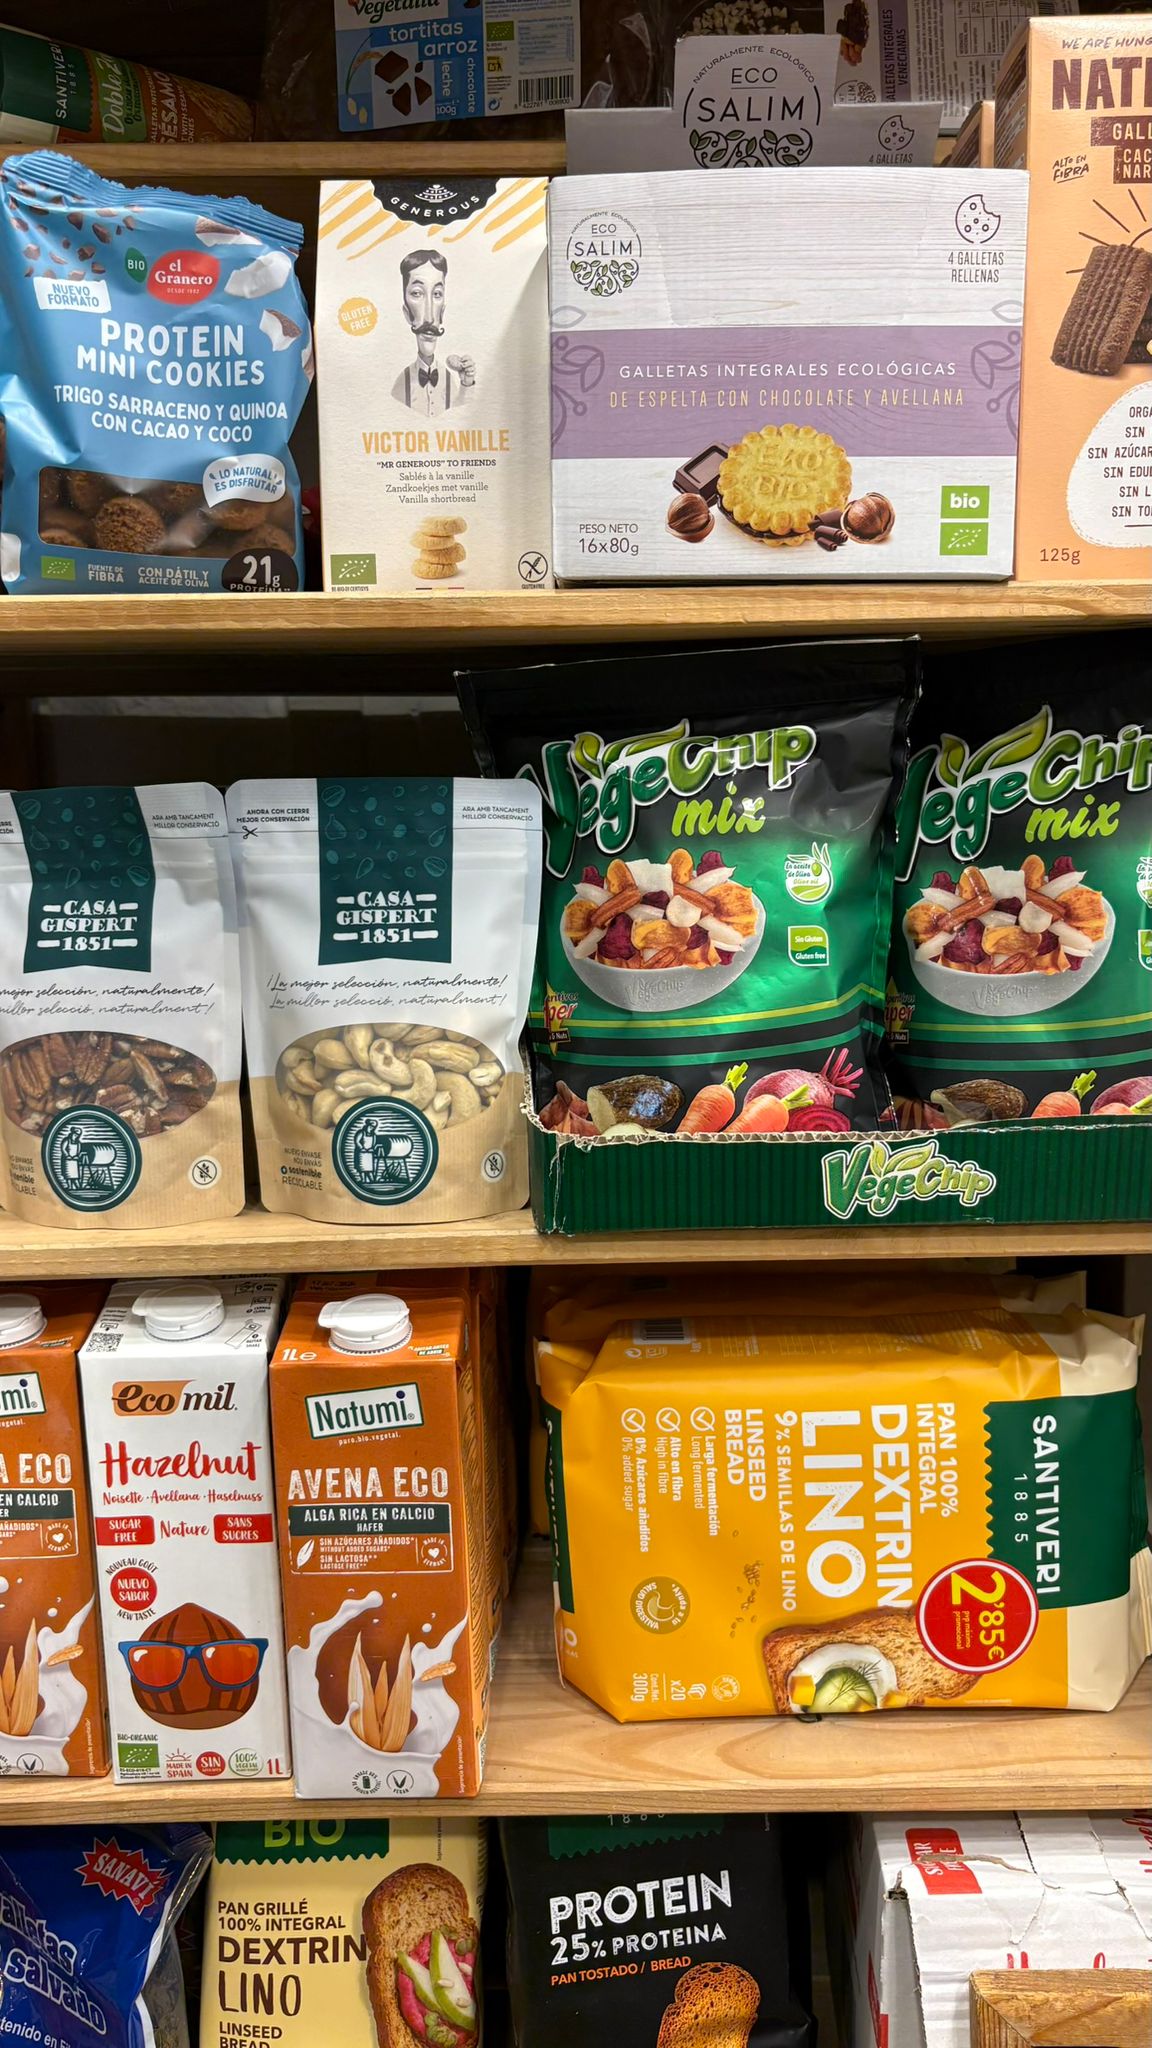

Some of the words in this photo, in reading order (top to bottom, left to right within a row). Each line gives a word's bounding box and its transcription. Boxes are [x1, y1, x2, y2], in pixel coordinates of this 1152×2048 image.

[389, 21, 463, 42] tortitas
[424, 39, 477, 57] arroz
[693, 45, 765, 84] NATURALMENTE
[769, 47, 815, 84] ECOLÓGICO
[897, 28, 906, 86] VENECIANAS
[442, 60, 453, 97] leche
[731, 68, 778, 84] ECO
[466, 57, 475, 113] chocolate
[697, 95, 804, 122] SALIM
[1052, 157, 1074, 169] ALTO
[1076, 155, 1087, 164] EN
[390, 195, 480, 217] GENEROUS
[591, 223, 617, 234] ECO
[574, 240, 632, 257] SALIM
[127, 259, 145, 271] BIO
[169, 258, 181, 272] el
[154, 270, 213, 285] Granero
[951, 269, 999, 283] RELLENAS
[52, 283, 90, 297] NUEVO
[47, 294, 100, 308] FORMATO
[350, 319, 371, 332] FREE
[101, 318, 244, 358] PROTEIN
[77, 345, 135, 379] MINI
[146, 360, 265, 388] COOKIES
[619, 364, 708, 379] GALLETAS
[717, 363, 829, 378] INTEGRALES
[837, 358, 957, 377] ECOLÓGICAS
[54, 384, 103, 406] TRIGO
[108, 392, 210, 422] SARRACENO
[214, 404, 225, 421] Y
[229, 401, 288, 422] QUINOA
[610, 391, 629, 409] DE
[639, 390, 707, 408] ESPELTA
[718, 390, 749, 407] CON
[759, 389, 854, 407] CHOCOLATE
[863, 389, 871, 406] Y
[881, 388, 964, 407] AVELLANA
[91, 412, 127, 433] CON
[131, 418, 190, 440] CACAO
[193, 423, 202, 440] Y
[208, 425, 252, 443] COCO
[1125, 426, 1145, 438] SIN
[362, 431, 430, 454] VICTOR
[436, 429, 510, 452] VANILLE
[399, 471, 427, 481] Sablés
[429, 472, 434, 481] à
[436, 472, 444, 480] la
[445, 471, 475, 480] vanille
[1103, 466, 1123, 478] SIN
[215, 481, 227, 492] ES
[228, 478, 278, 494] DISFRUTAR
[385, 483, 440, 494] Zandkoekjes
[441, 483, 458, 492] met
[459, 482, 489, 492] vanille
[399, 494, 429, 504] Vanilla
[430, 493, 476, 503] shortbread
[950, 492, 980, 509] bio
[1112, 506, 1132, 518] SIN
[579, 524, 607, 533] PESO
[609, 523, 639, 533] NETO
[578, 537, 640, 556] 16x80g
[1040, 548, 1081, 565] 125g
[88, 564, 113, 573] FUENTE
[88, 571, 124, 583] FIBRA
[243, 555, 281, 587] 21g
[247, 808, 269, 816] AHORA
[671, 781, 766, 837] mix
[260, 815, 311, 824] CONSERVACIÓN
[1025, 794, 1120, 843] mix
[357, 890, 415, 907] CASA
[63, 900, 118, 916] CASA
[336, 908, 437, 925] GISPERT
[40, 916, 137, 933] GISPERT
[62, 936, 113, 951] 1851
[360, 928, 413, 944] 1851
[823, 1143, 995, 1218] VegeChip
[774, 1410, 798, 1441] 9%
[937, 1403, 956, 1449] PAN
[654, 1436, 667, 1458] High
[669, 1436, 679, 1458] Alto
[705, 1435, 717, 1466] Larga
[725, 1409, 745, 1485] BREAD
[745, 1409, 767, 1501] LINSEED
[99, 1440, 262, 1488] Hazelnut
[658, 1459, 665, 1468] in
[671, 1460, 679, 1474] en
[916, 1403, 937, 1514] INTEGRAL
[19, 1453, 72, 1484] ECO
[288, 1466, 384, 1501] AVENA
[393, 1466, 450, 1498] ECO
[658, 1468, 670, 1494] fibre
[672, 1475, 684, 1502] fibra
[939, 1457, 959, 1517] 100%
[103, 1492, 144, 1506] Noisette
[151, 1490, 201, 1502] Avellana
[207, 1489, 263, 1502] Haselnuss
[775, 1446, 794, 1534] SEMILLAS
[17, 1493, 59, 1506] CALCIO
[706, 1466, 721, 1536] fermentación
[801, 1410, 866, 1598] LINO
[871, 1405, 913, 1607] DEXTRIN
[1033, 1414, 1061, 1597] SANTIVERI
[227, 1517, 253, 1528] SANS
[304, 1508, 335, 1522] ALGA
[339, 1508, 368, 1522] RICA
[372, 1507, 388, 1521] EN
[391, 1507, 435, 1521] CALCIO
[109, 1519, 141, 1530] SUGAR
[160, 1520, 210, 1538] Nature
[357, 1522, 384, 1532] HAFER
[114, 1532, 137, 1543] FREE
[222, 1529, 259, 1541] SUCRES
[320, 1537, 332, 1546] SIN
[334, 1535, 372, 1546] AZÚCARES
[320, 1554, 333, 1563] SIN
[780, 1539, 795, 1563] DE
[118, 1578, 149, 1590] NUEVO
[782, 1568, 797, 1611] LINO
[119, 1590, 150, 1602] SABOR
[630, 1672, 648, 1702] 300g
[117, 1733, 158, 1742] BIO-ORGANIC
[200, 1757, 221, 1767] SIN
[235, 1752, 258, 1763] 100%
[167, 1769, 194, 1778] SPAIN
[267, 1758, 284, 1775] 1L
[263, 1819, 346, 1848] BIO
[218, 1900, 249, 1916] PAN
[254, 1897, 309, 1916] GRILLÉ
[548, 1869, 732, 1935] PROTEIN
[218, 1916, 262, 1931] 100%
[265, 1915, 346, 1931] INTEGRAL
[218, 1934, 368, 1966] DEXTRIN
[546, 1932, 607, 1967] 25%
[612, 1921, 727, 1956] PROTEINA
[551, 1971, 577, 1986] PAN
[579, 1963, 638, 1982] TOSTADO
[651, 1955, 691, 1972] BREAD
[217, 1969, 302, 2017] LINO
[219, 2020, 283, 2040] LINSEED
